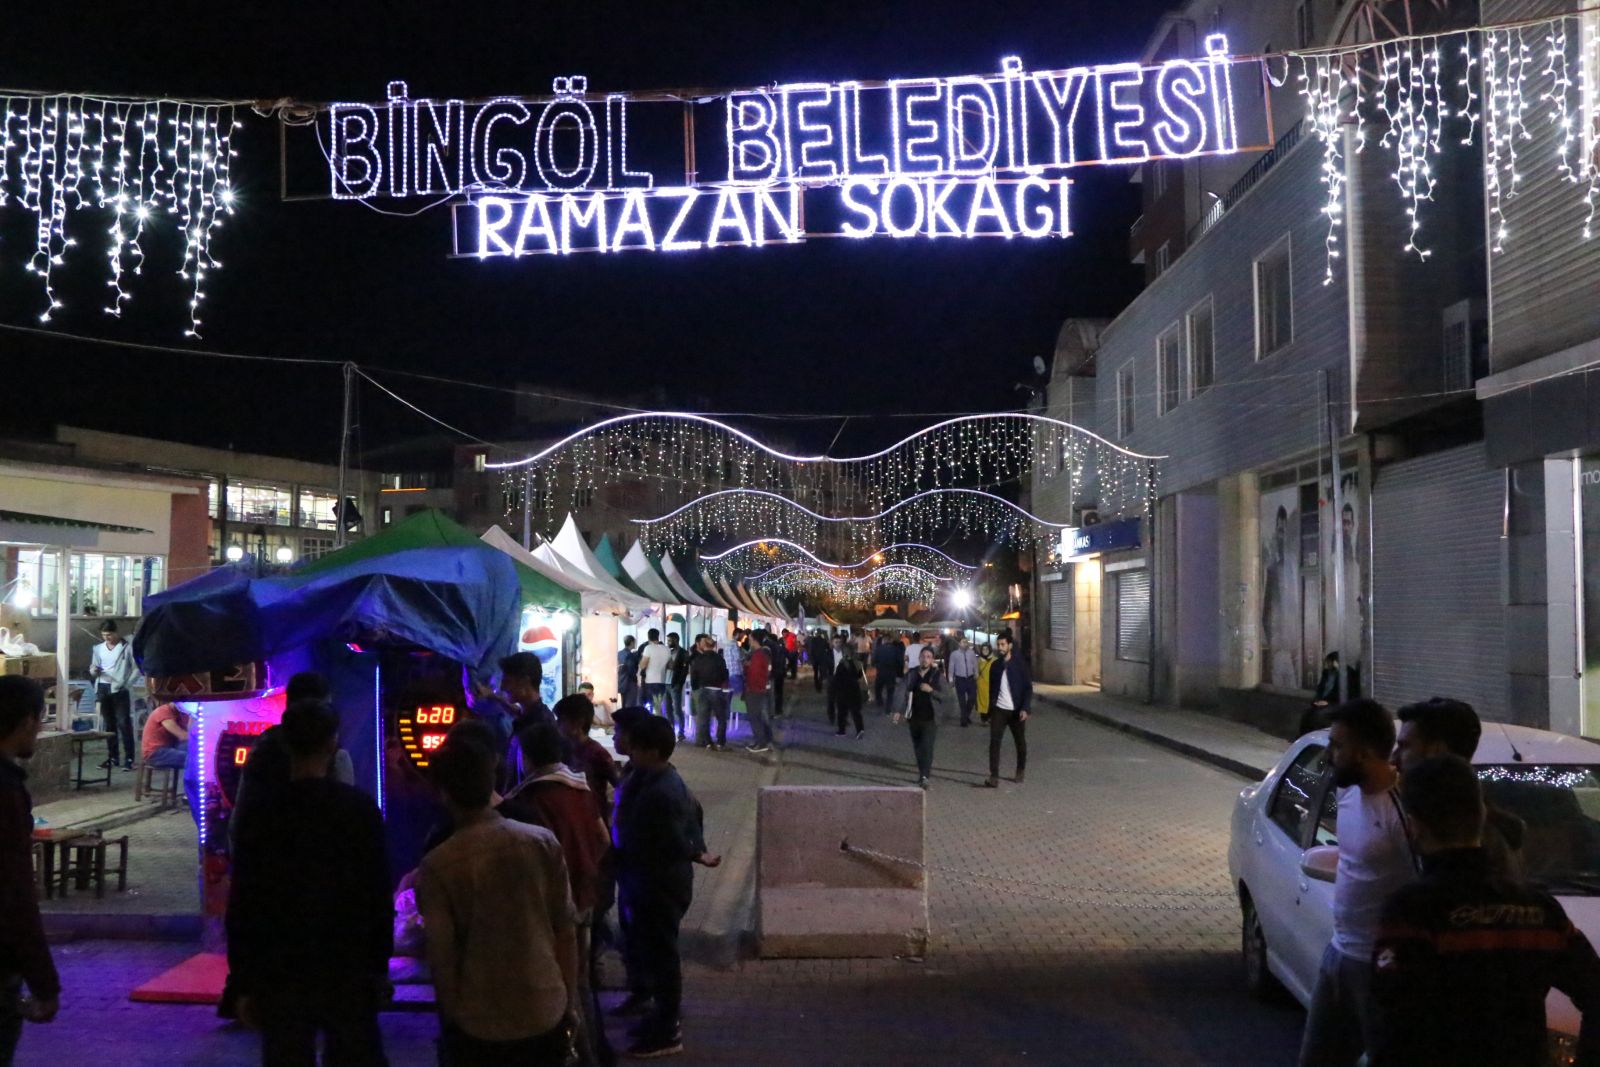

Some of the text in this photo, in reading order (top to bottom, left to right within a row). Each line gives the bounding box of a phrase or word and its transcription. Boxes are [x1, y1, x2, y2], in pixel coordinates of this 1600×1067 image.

[330, 33, 1238, 199] BİNGÖL BELEDİYESİ
[478, 184, 799, 258] RAMAZAN
[422, 735, 447, 749] 95
